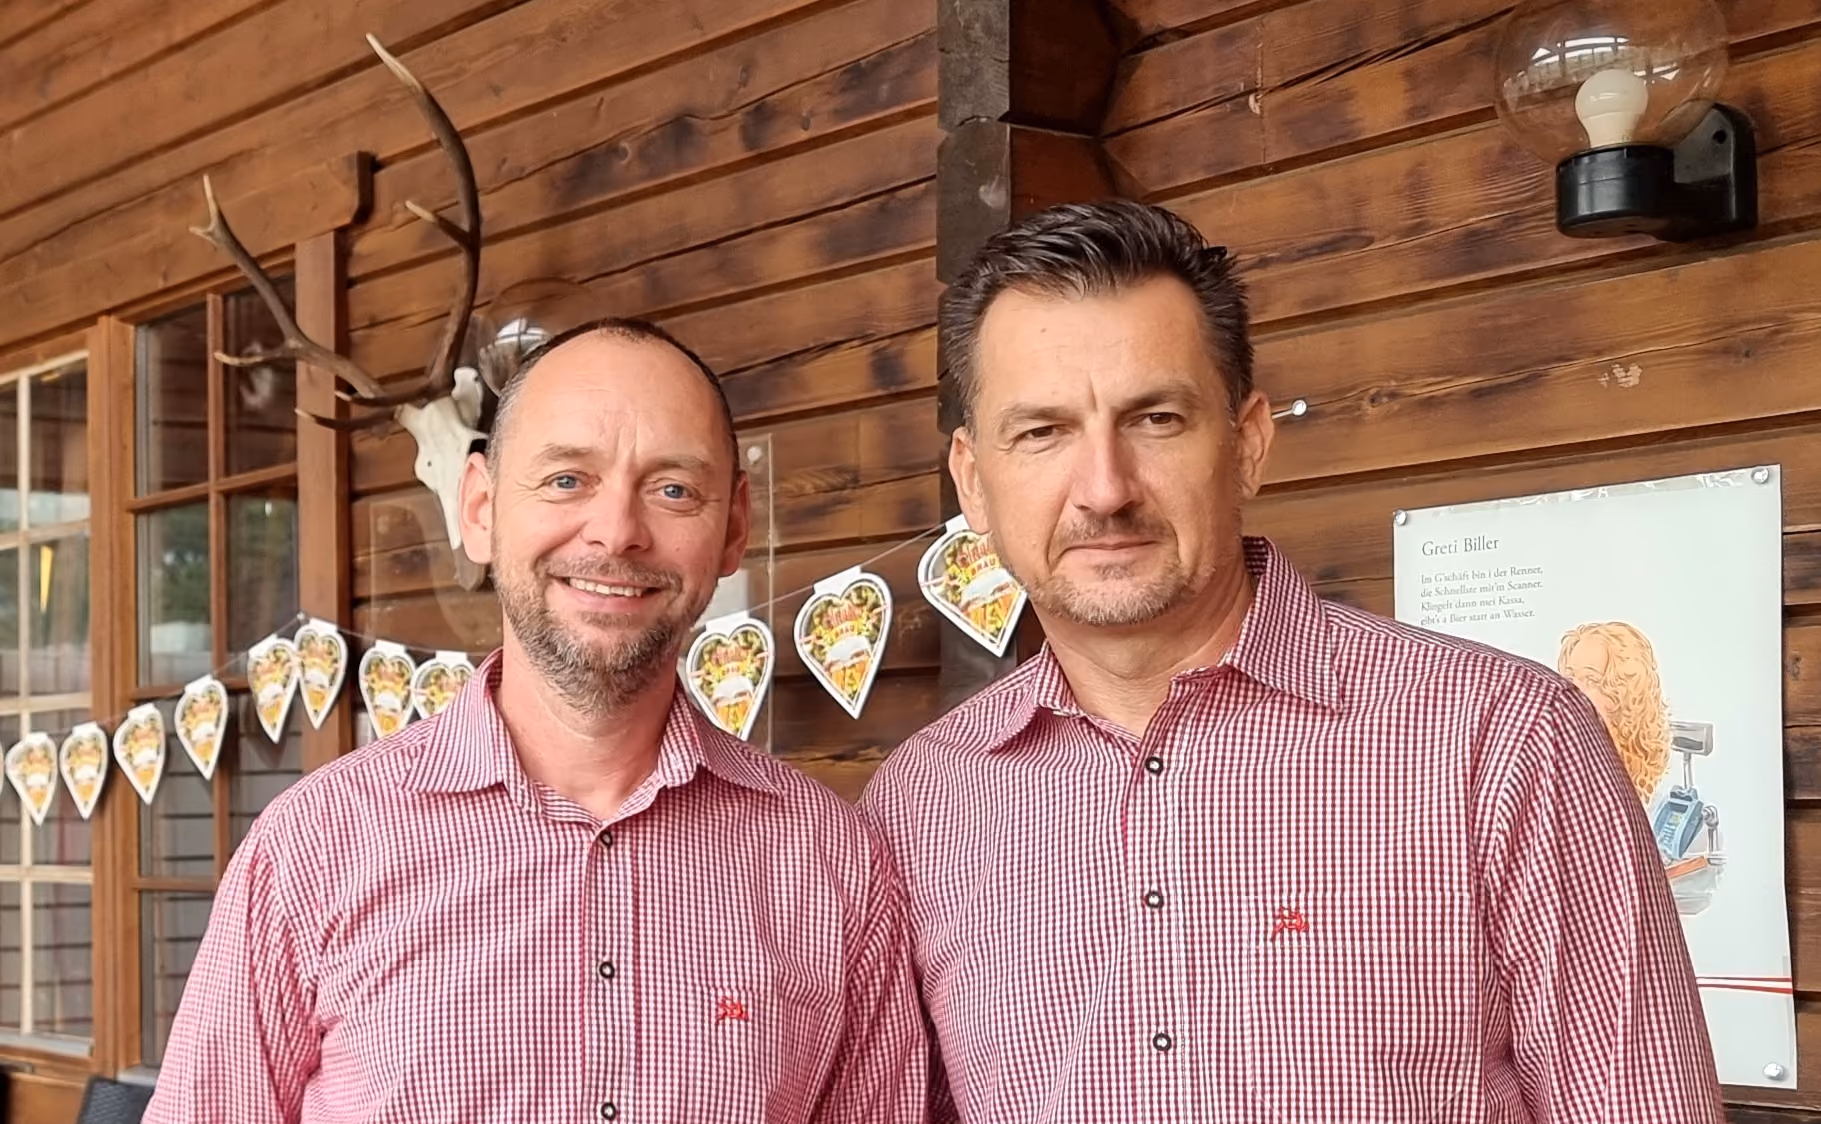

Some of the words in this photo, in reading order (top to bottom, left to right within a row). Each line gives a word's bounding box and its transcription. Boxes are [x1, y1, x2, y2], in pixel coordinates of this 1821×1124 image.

[1422, 540, 1458, 556] Greti
[1464, 535, 1499, 553] Biller
[1421, 574, 1432, 584] Im
[1472, 570, 1486, 579] bin
[1494, 568, 1507, 578] der
[1421, 588, 1433, 598] die
